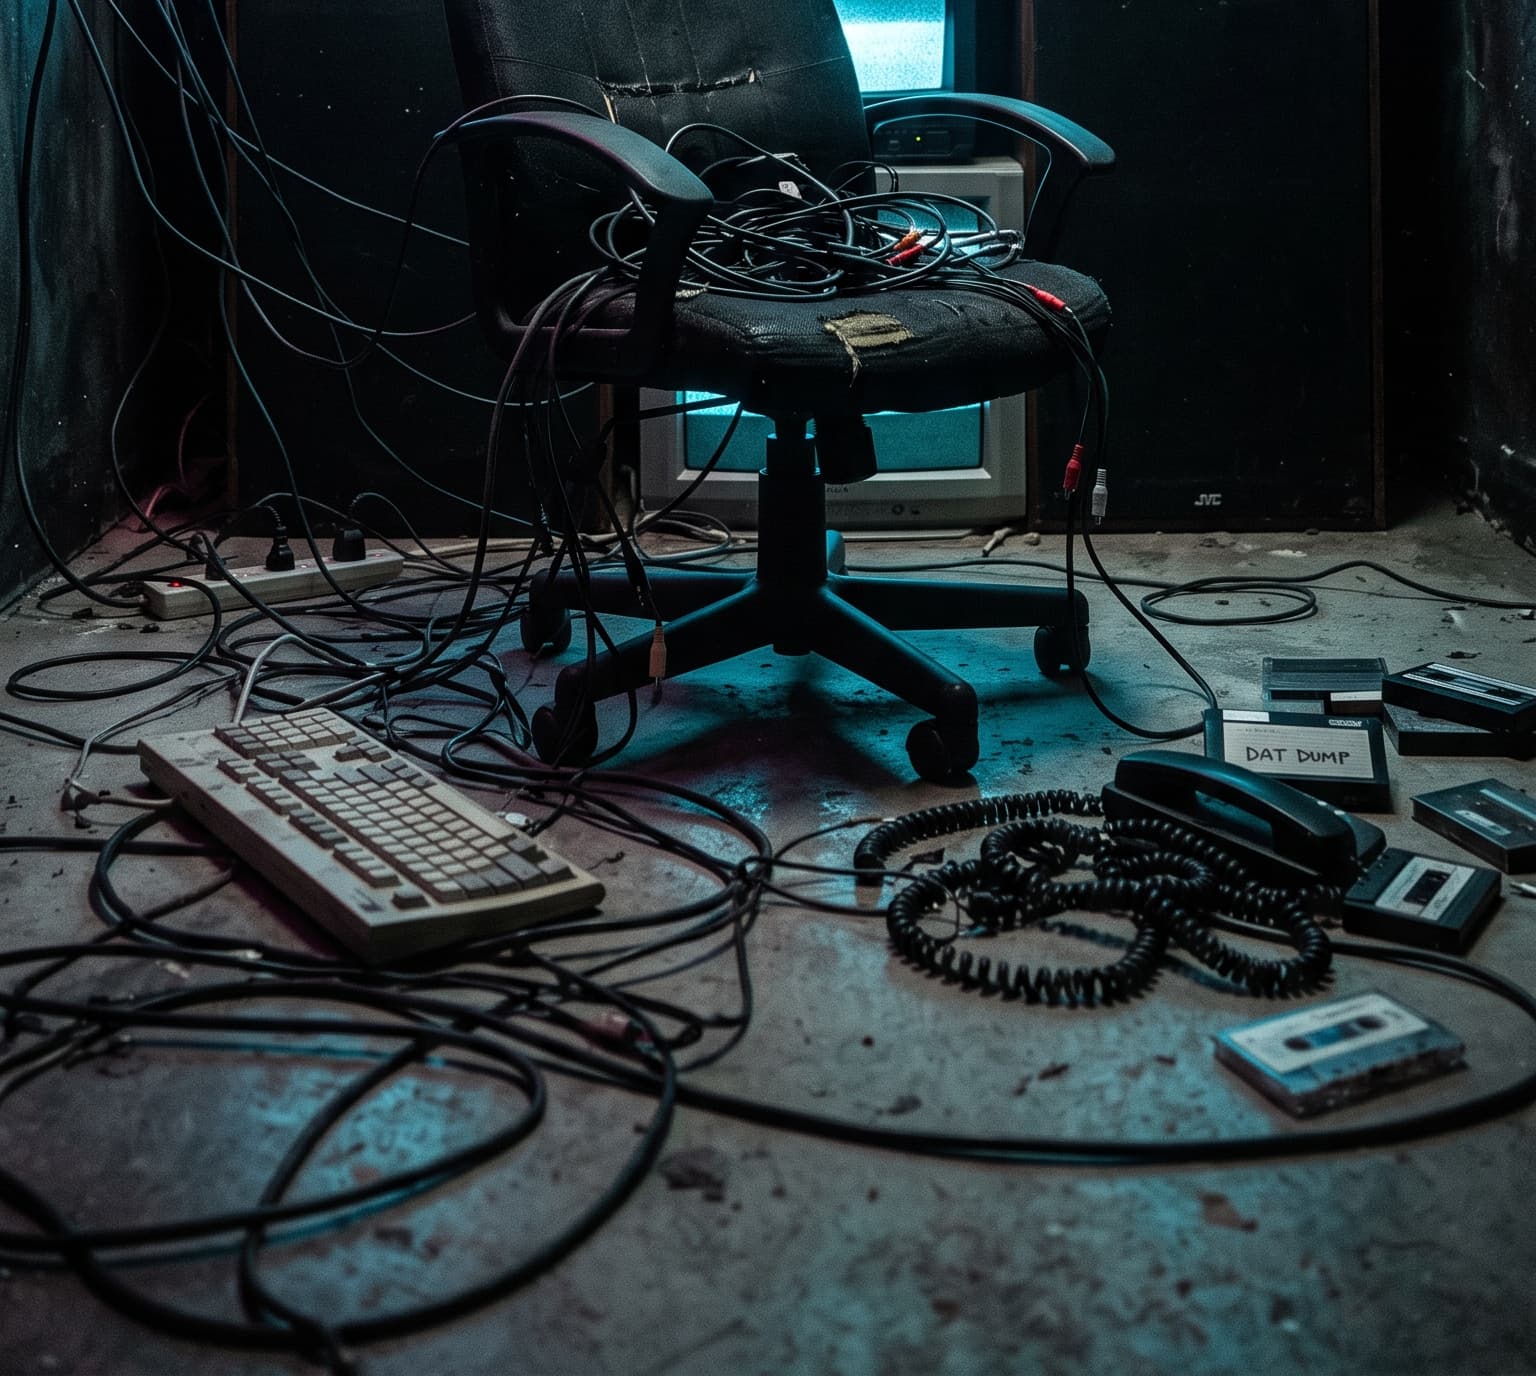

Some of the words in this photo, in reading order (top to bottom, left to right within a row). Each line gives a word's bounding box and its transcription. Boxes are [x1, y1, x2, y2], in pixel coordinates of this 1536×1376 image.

[1194, 493, 1222, 506] JVC
[1246, 746, 1287, 762] DAT
[1296, 749, 1350, 764] DUMP
